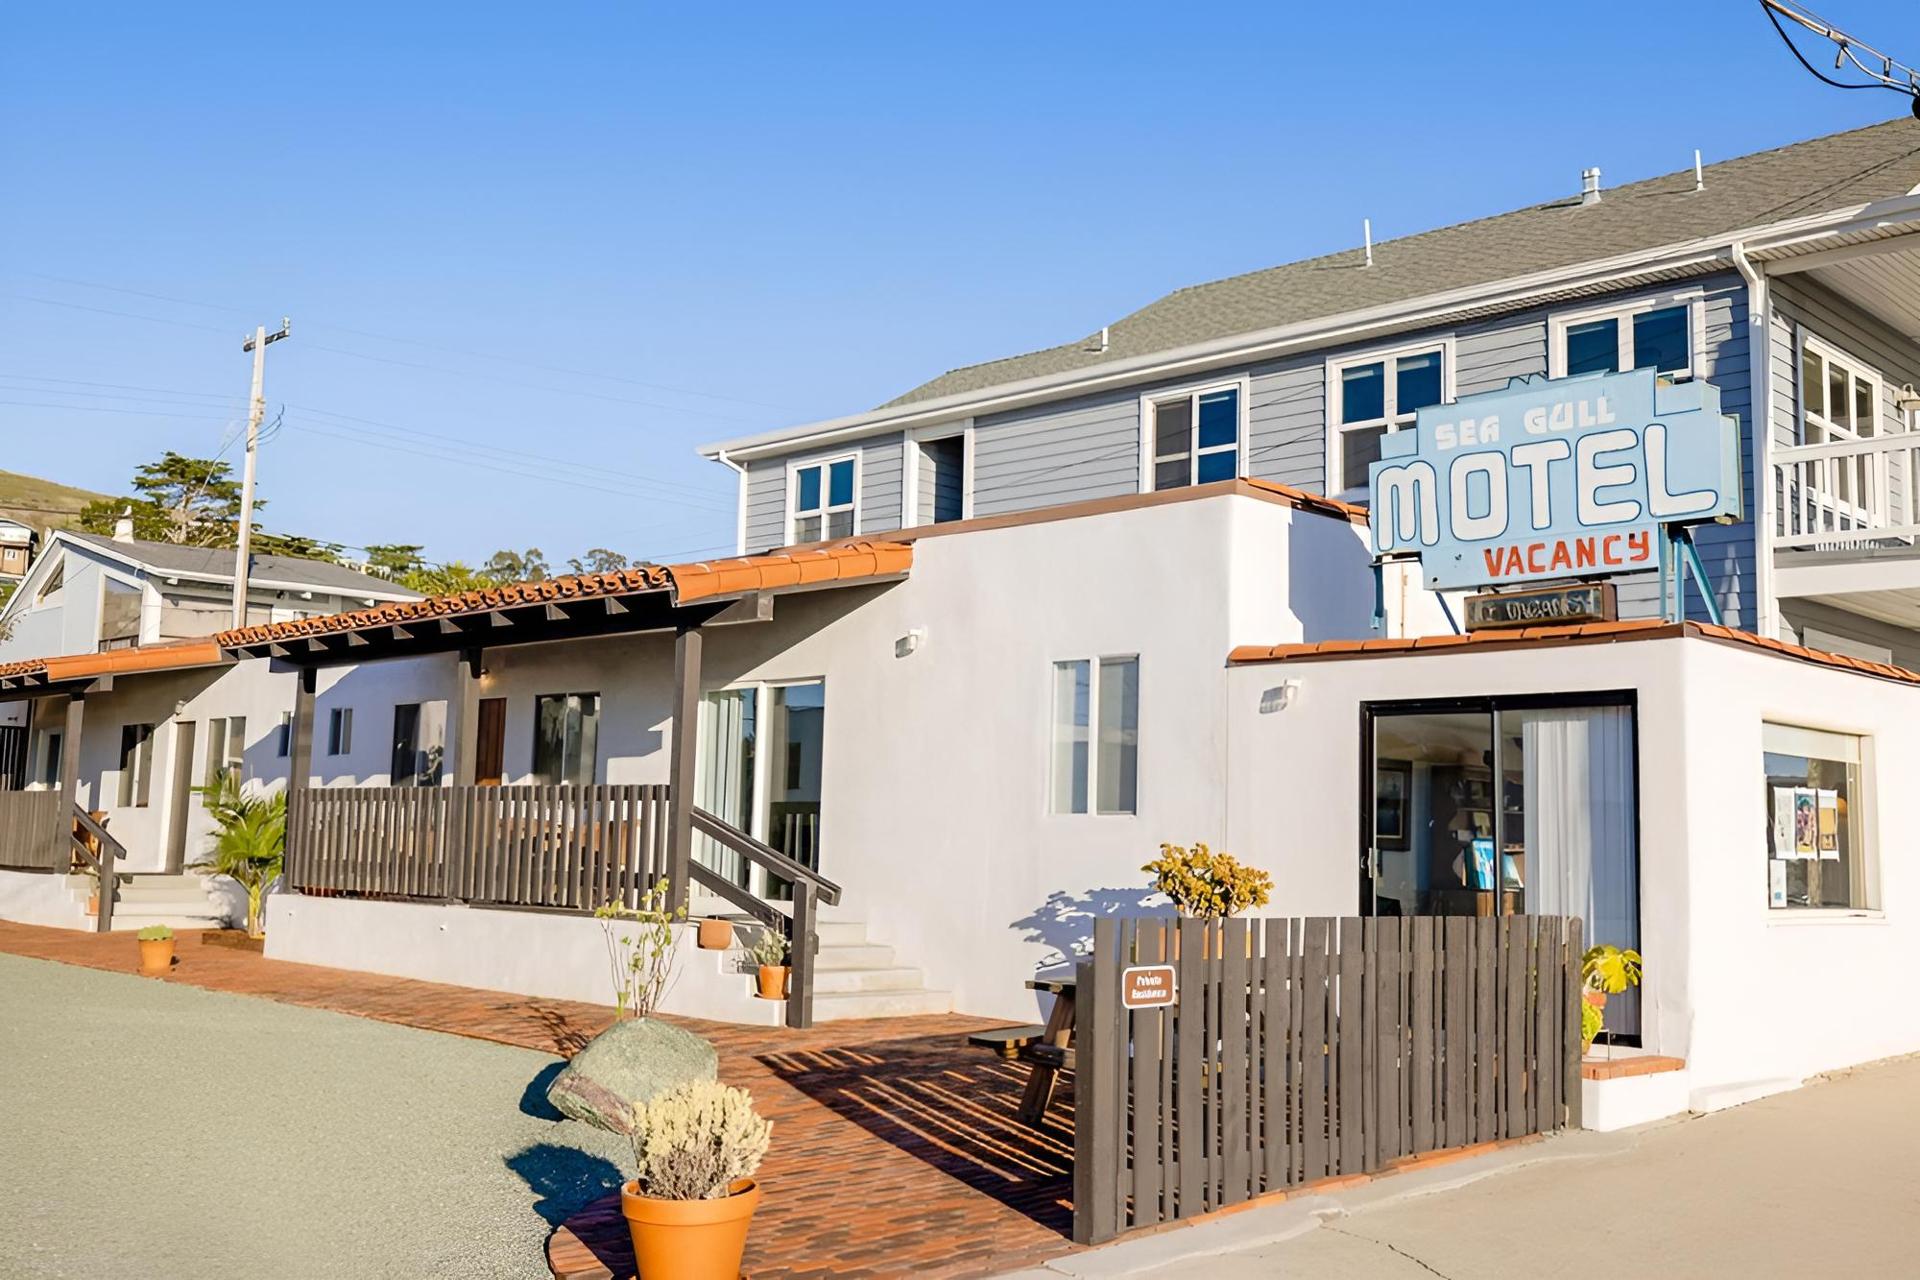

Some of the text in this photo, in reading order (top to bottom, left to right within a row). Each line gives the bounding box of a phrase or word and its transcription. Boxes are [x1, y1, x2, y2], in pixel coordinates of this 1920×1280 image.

[1434, 397, 1616, 451] SEA GULL
[1376, 423, 1718, 552] MOTEL
[1483, 530, 1650, 577] VACANCY
